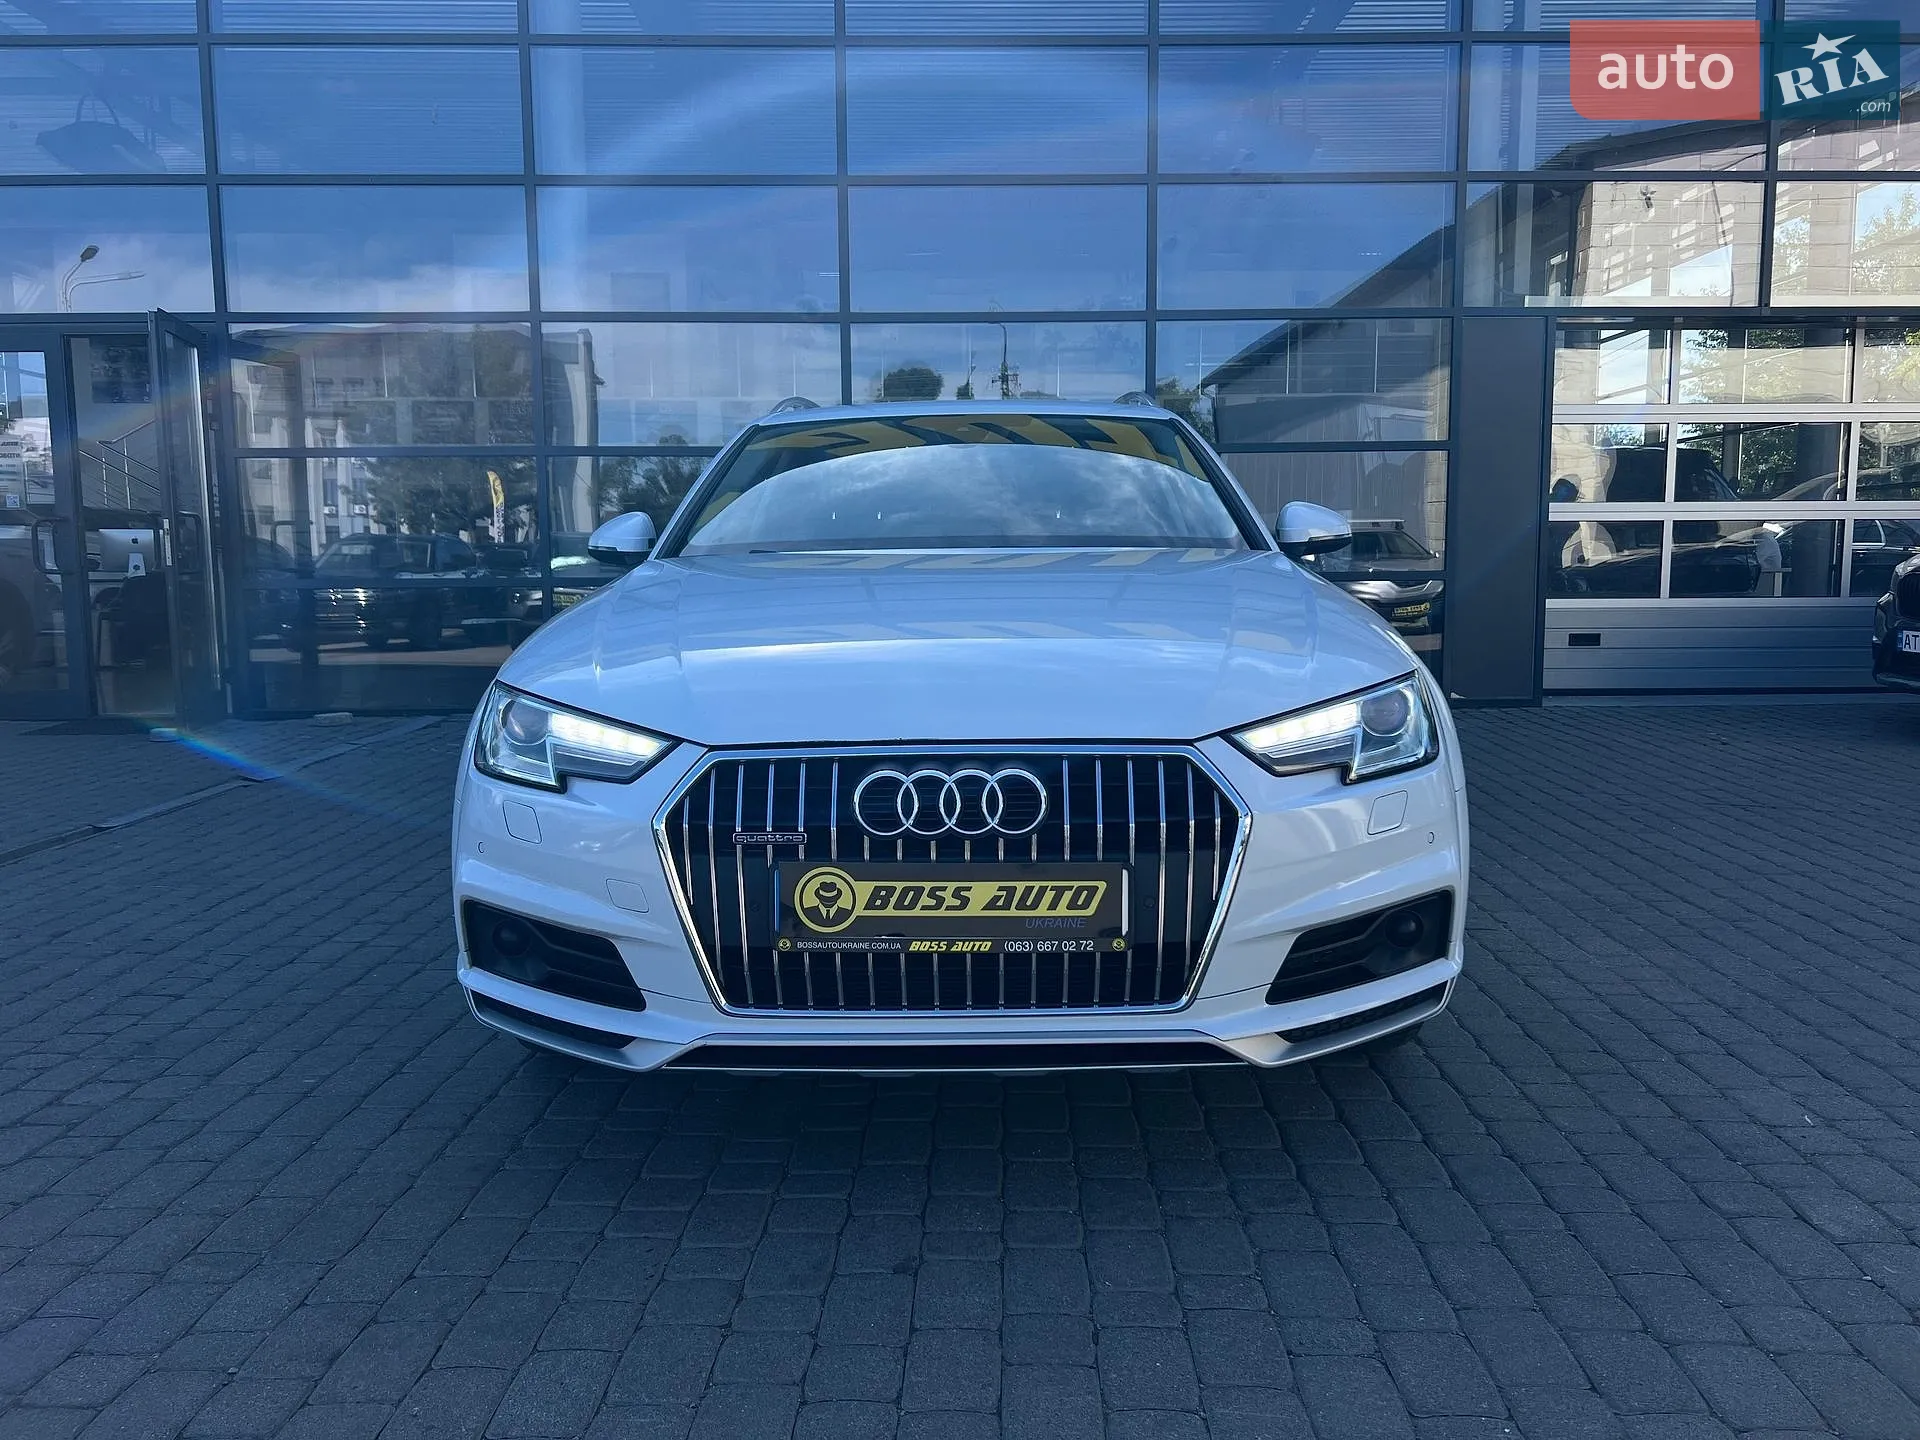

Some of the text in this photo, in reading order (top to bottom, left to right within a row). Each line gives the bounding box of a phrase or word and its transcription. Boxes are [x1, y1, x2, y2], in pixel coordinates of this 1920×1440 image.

[736, 834, 803, 843] quattro
[863, 885, 1100, 911] BOSS AUTO
[1025, 917, 1087, 929] UKRAINE
[909, 941, 992, 951] BOSS AUTO
[1004, 940, 1094, 952] (063) 667 02 72
